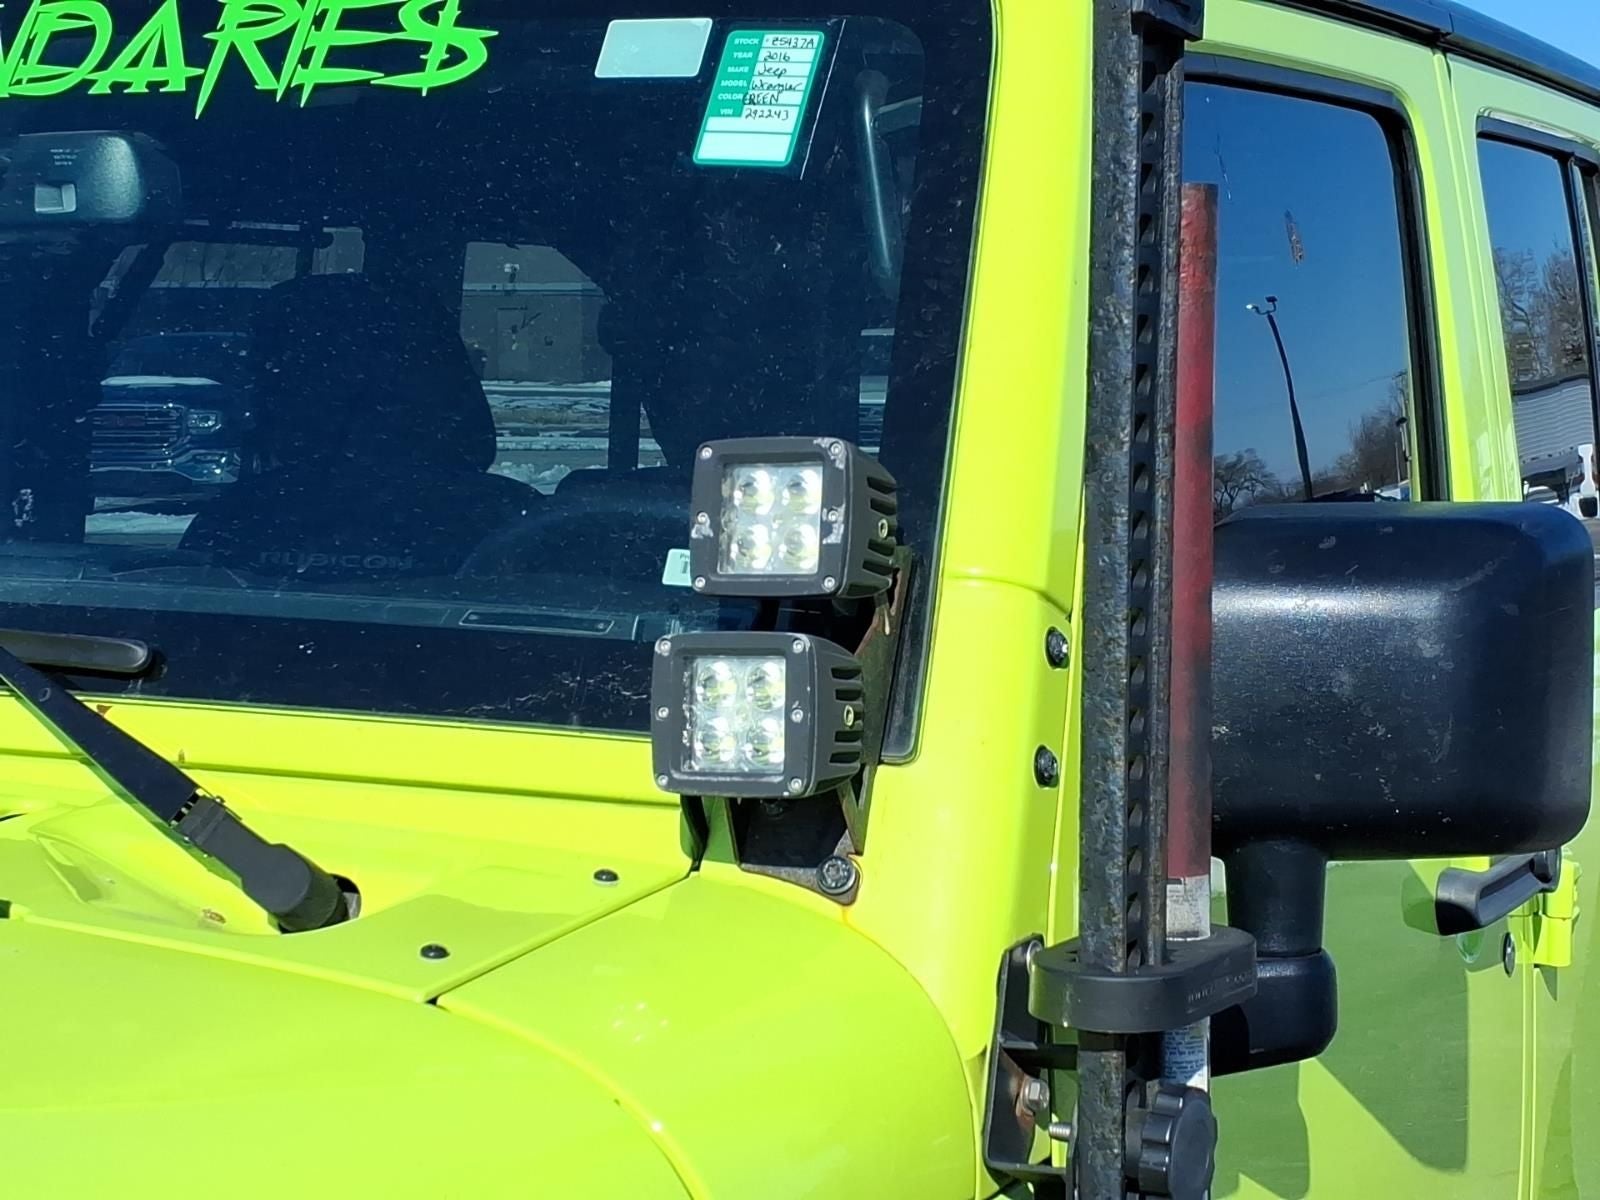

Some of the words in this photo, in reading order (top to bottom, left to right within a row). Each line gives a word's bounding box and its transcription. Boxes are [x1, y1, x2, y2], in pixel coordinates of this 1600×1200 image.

[763, 51, 790, 62] 2016
[758, 63, 787, 79] Jeep
[743, 92, 779, 105] GREEN
[745, 108, 789, 121] 292243
